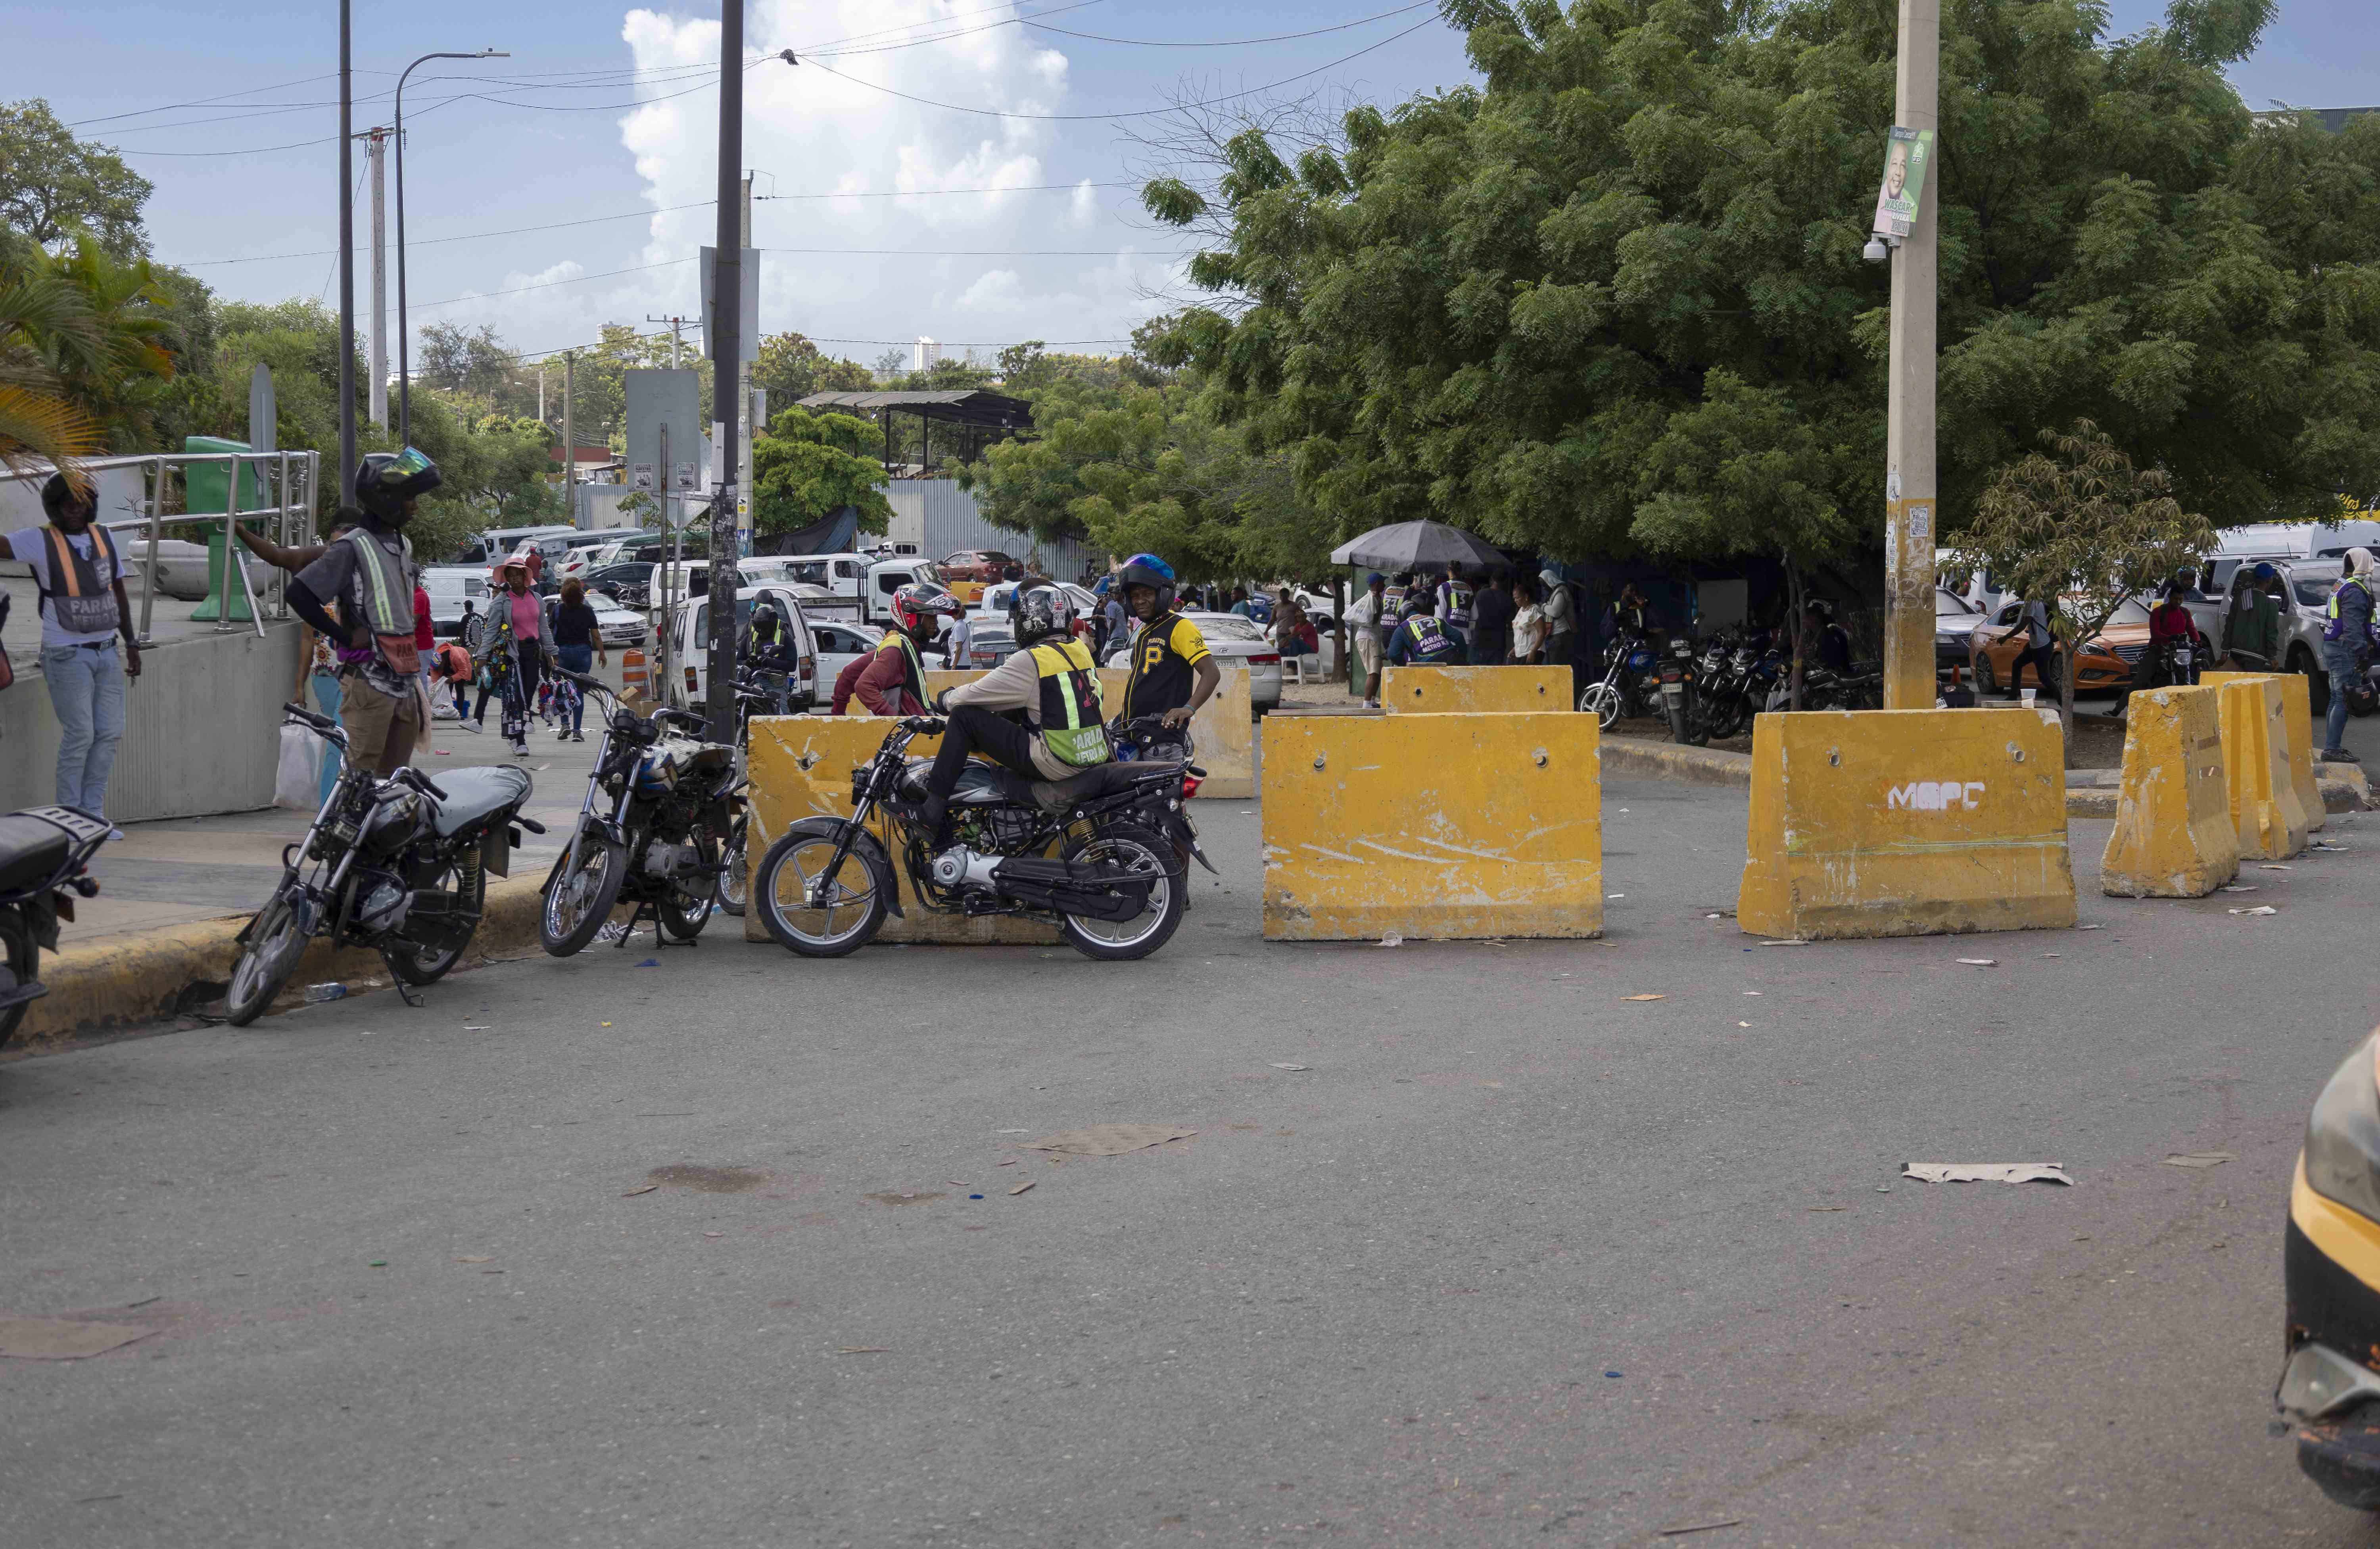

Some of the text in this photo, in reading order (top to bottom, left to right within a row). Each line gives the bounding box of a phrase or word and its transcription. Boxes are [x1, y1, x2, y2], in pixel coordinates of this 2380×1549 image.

[1885, 198, 1911, 213] WASCAR
[1384, 599, 1397, 611] 37
[1416, 619, 1436, 632] 12
[1422, 642, 1441, 653] METRO
[1142, 644, 1165, 675] P
